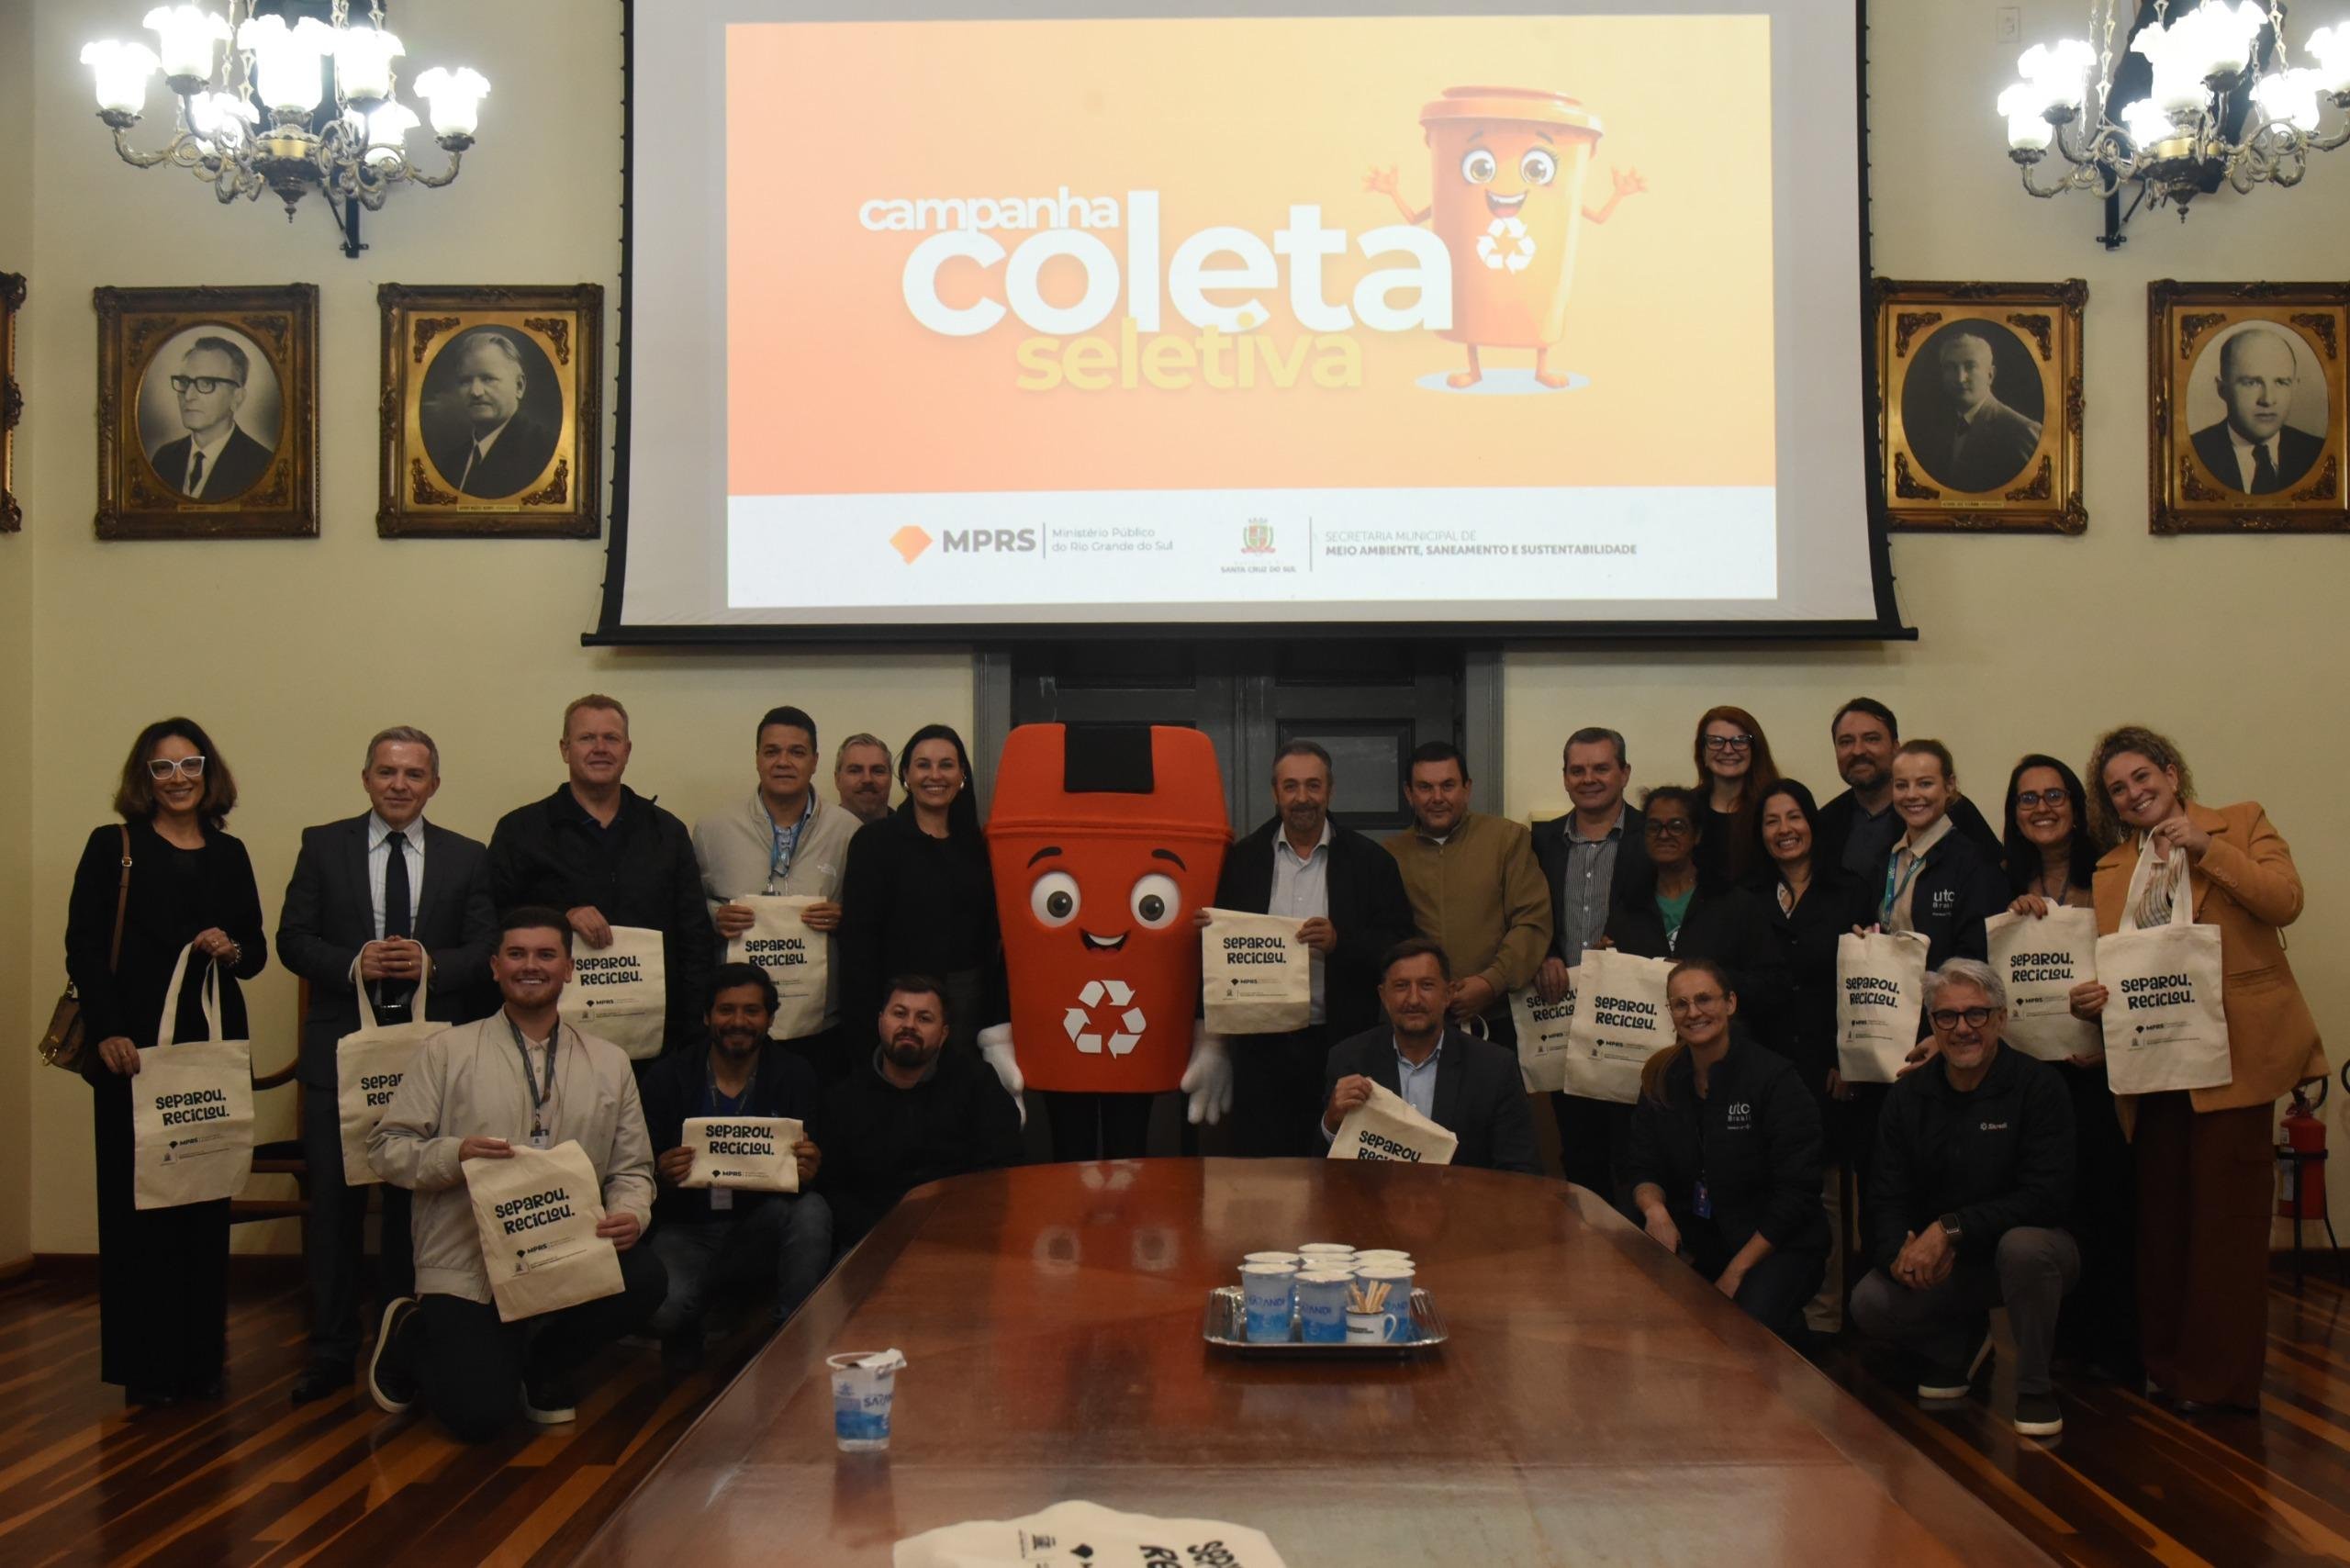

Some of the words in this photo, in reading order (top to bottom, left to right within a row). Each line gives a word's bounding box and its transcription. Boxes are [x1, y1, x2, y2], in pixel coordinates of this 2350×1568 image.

[858, 186, 1121, 237] campanha
[901, 190, 1453, 336] coleta
[1015, 311, 1362, 391] seletiva
[942, 527, 1037, 554] MPRS
[1052, 527, 1109, 539] Ministério
[1112, 526, 1156, 538] Público
[1325, 531, 1393, 543] SECRETARIA
[1396, 530, 1459, 543] MUNICIPAL
[1460, 530, 1477, 542] DE
[1051, 540, 1067, 553] do
[1069, 540, 1089, 552] Rio
[1091, 540, 1134, 552] Grande
[1136, 539, 1153, 552] do
[1155, 539, 1174, 551] Sul
[1326, 544, 1358, 556] MEIO
[1360, 544, 1424, 557] AMBIENTE,
[1426, 544, 1510, 555] SANEAMENTO
[1511, 544, 1518, 555] E
[1520, 543, 1638, 555] SUSTENTABILIDADE
